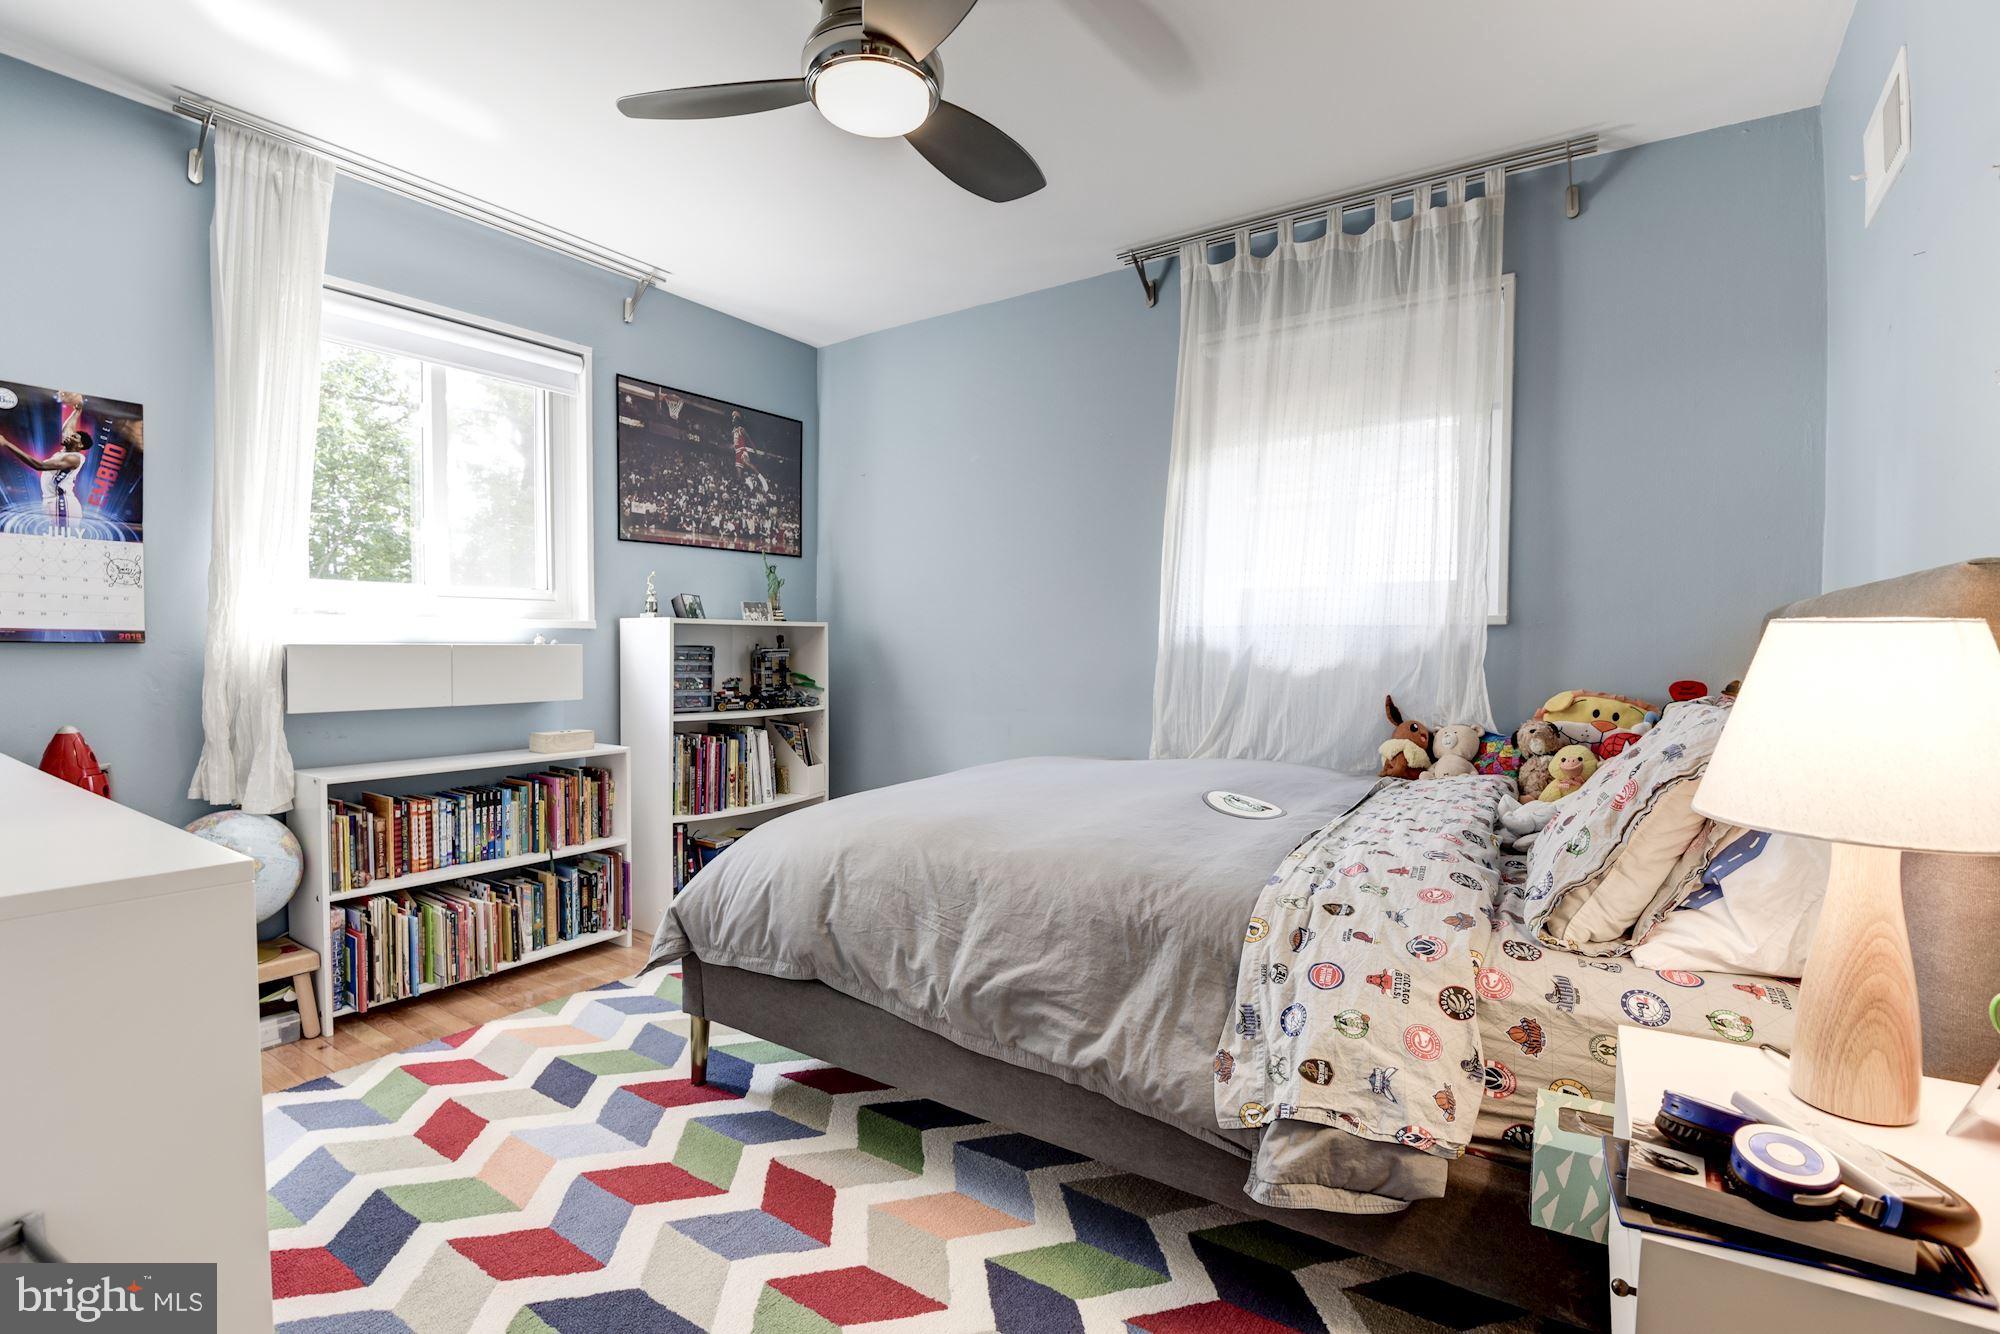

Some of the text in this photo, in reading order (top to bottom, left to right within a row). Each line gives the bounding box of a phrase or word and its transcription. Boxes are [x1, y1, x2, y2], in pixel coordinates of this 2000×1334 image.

[97, 418, 113, 449] JOEL
[88, 443, 128, 510] EMBIID
[1274, 964, 1288, 984] NETS
[1393, 971, 1403, 996] BULLS
[1459, 990, 1475, 1019] TORONTO
[1554, 976, 1574, 1014] MAGIC
[1526, 1020, 1542, 1055] KNICKS
